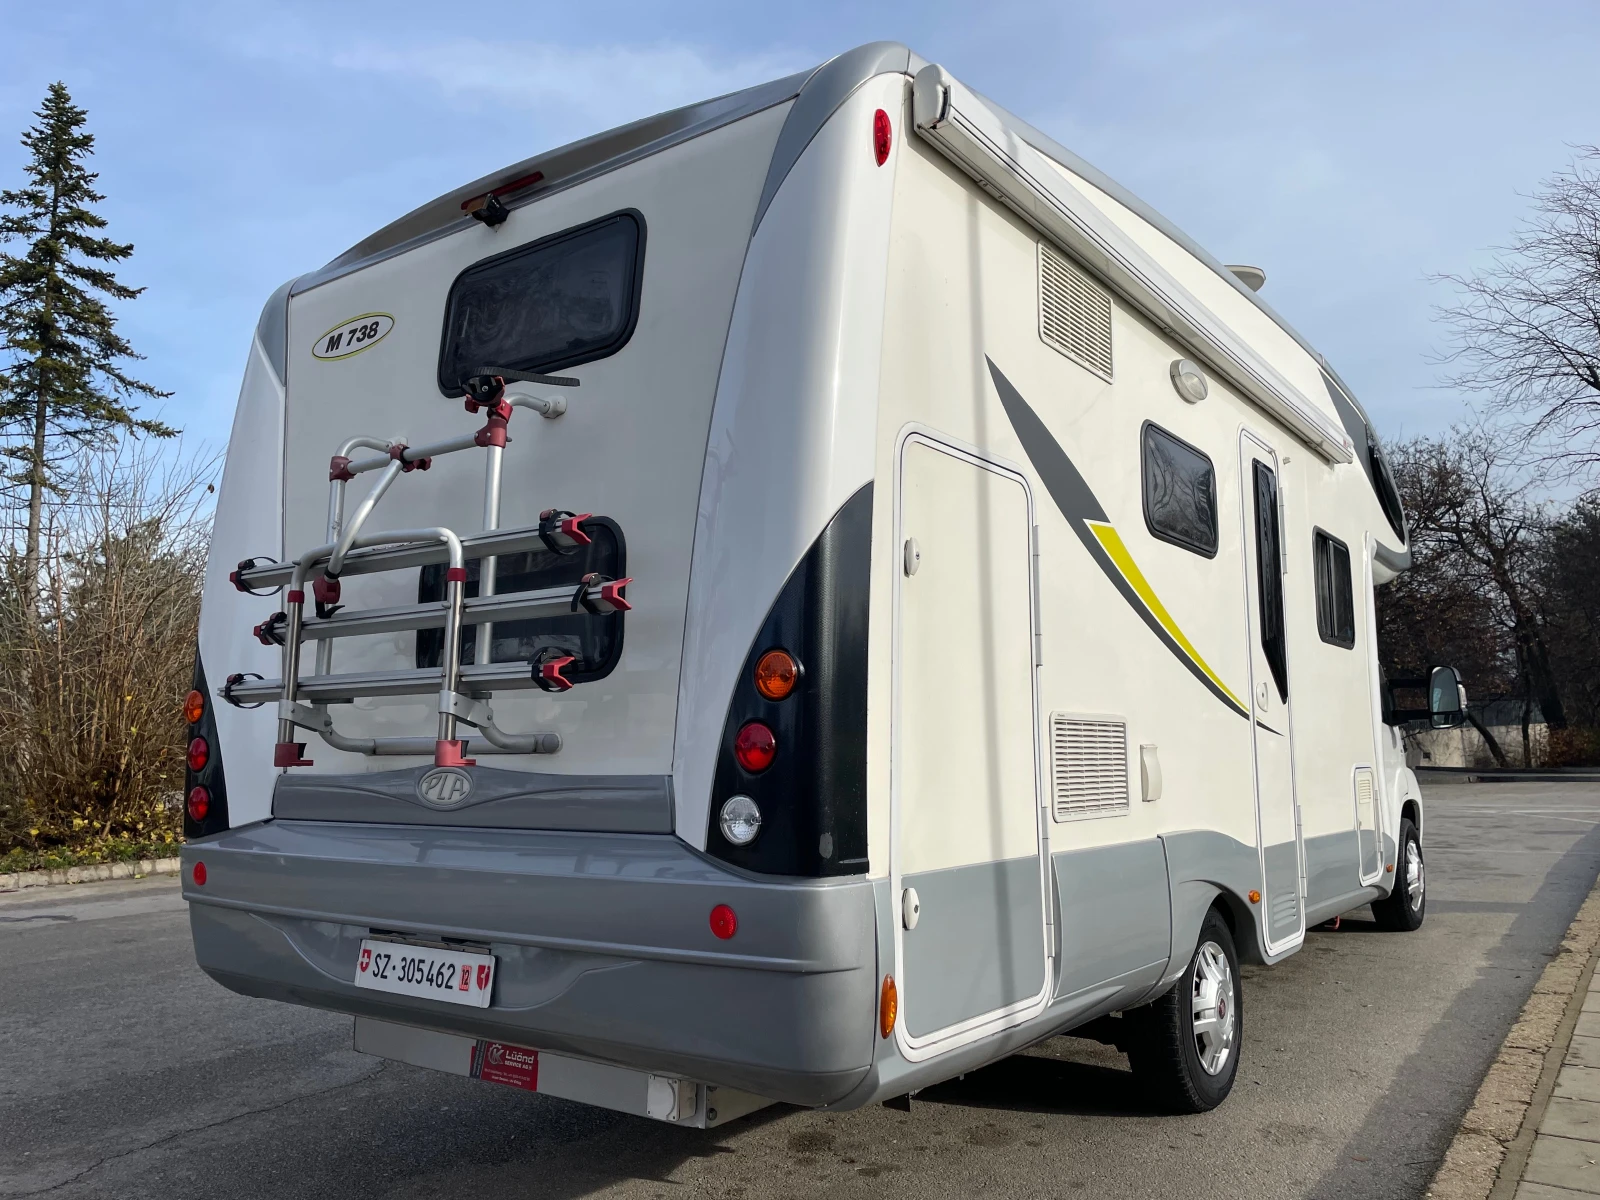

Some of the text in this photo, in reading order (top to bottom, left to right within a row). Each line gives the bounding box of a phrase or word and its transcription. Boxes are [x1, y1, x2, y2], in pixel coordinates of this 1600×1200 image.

[325, 321, 379, 353] M 738
[505, 1050, 534, 1063] Lüönd
